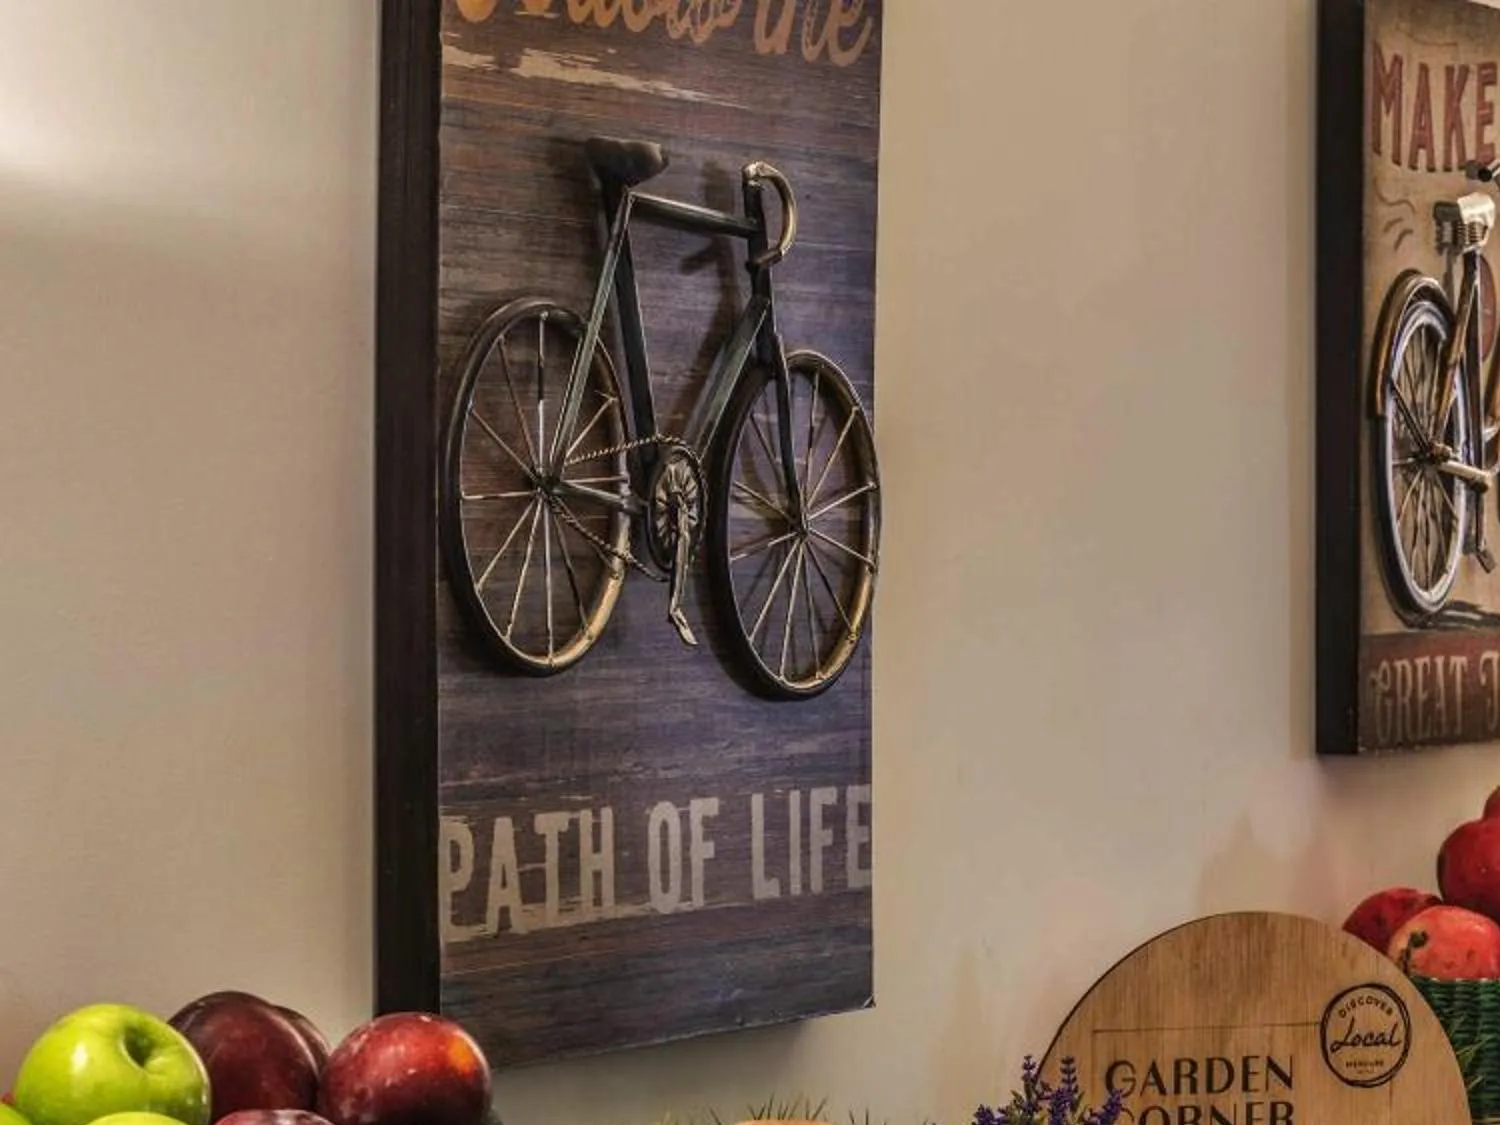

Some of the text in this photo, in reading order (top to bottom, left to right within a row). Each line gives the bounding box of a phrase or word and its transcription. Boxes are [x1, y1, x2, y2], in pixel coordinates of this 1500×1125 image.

[1372, 38, 1498, 173] MAKE
[1369, 655, 1468, 746] GREAT
[438, 784, 872, 944] PATH OF LIFE
[1330, 1016, 1402, 1054] Local
[1338, 995, 1393, 1019] DISCOVER
[1105, 1055, 1294, 1099] GARDEN
